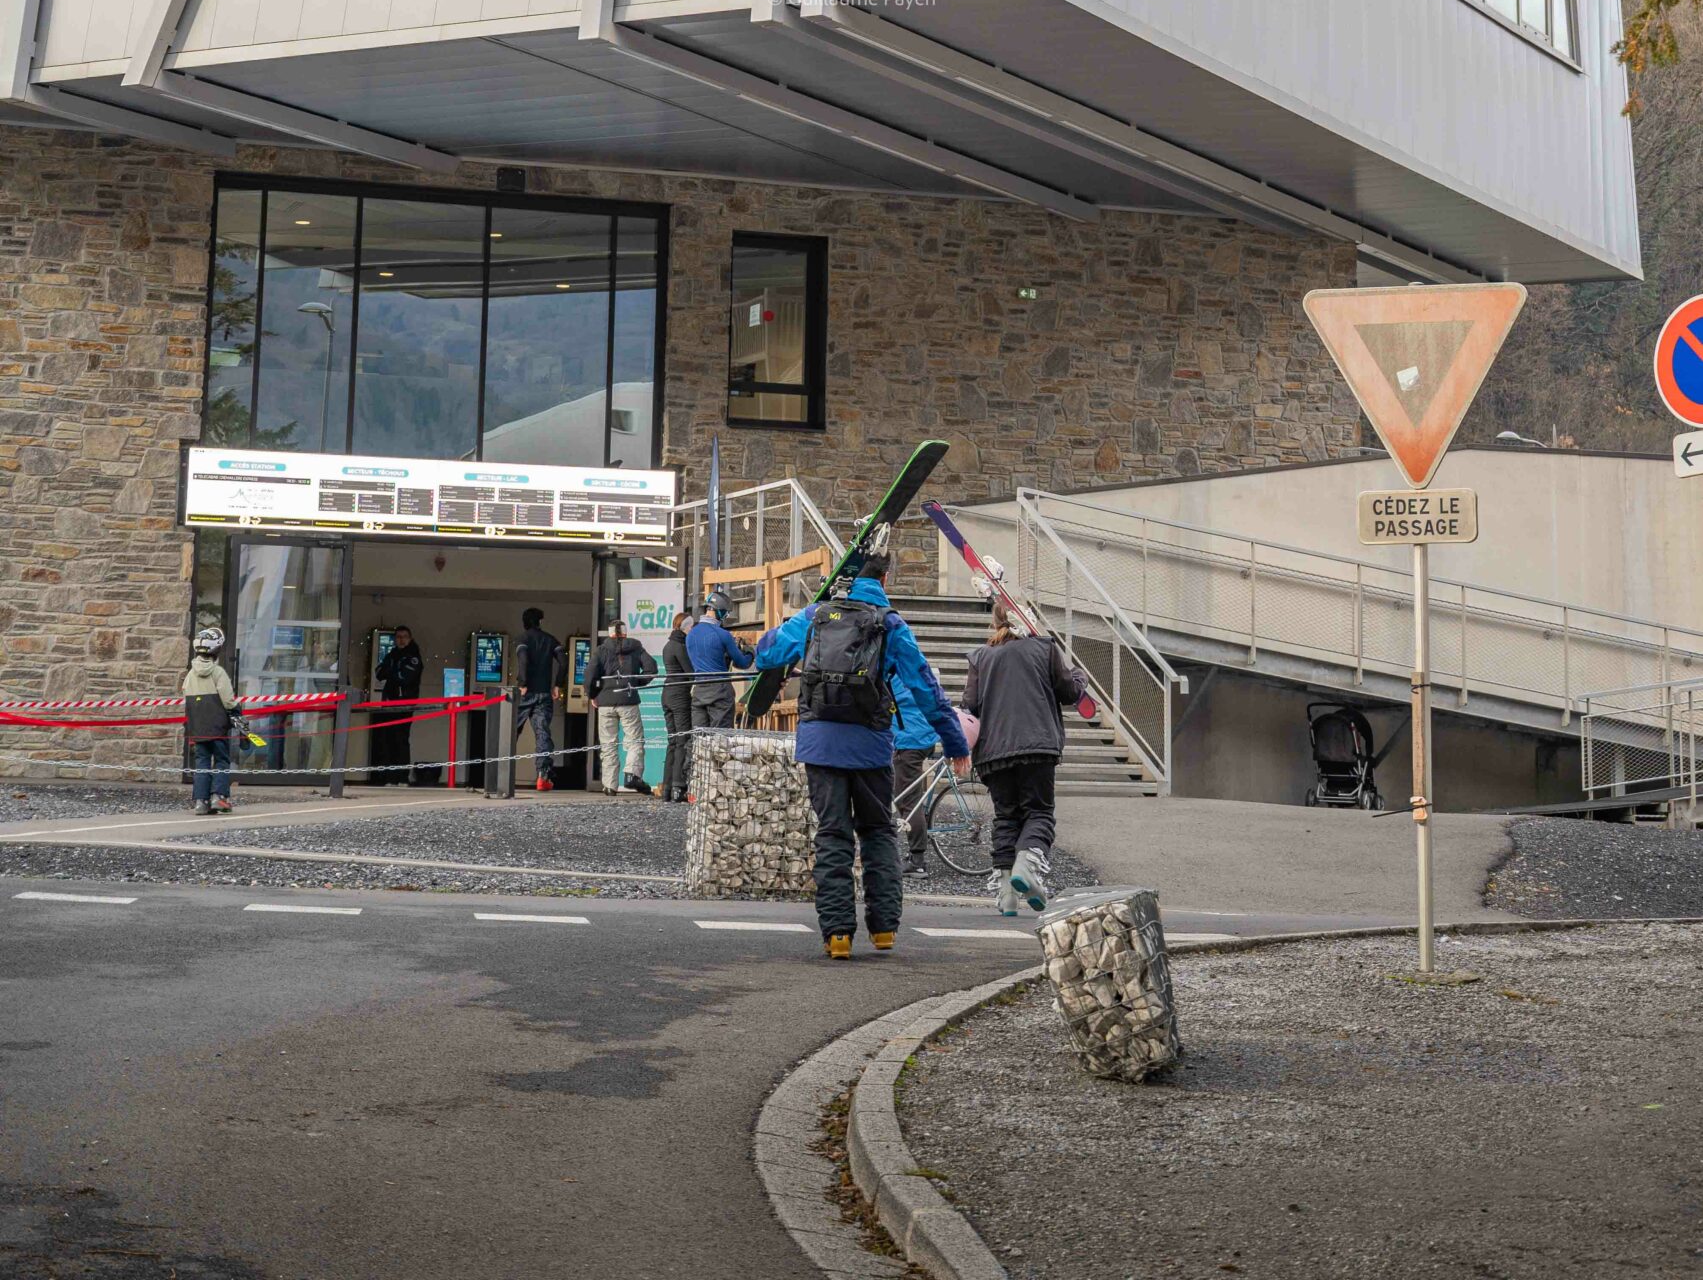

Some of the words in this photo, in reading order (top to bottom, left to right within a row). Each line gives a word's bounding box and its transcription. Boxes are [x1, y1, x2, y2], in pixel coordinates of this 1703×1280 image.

[1372, 496, 1430, 515] CÉDEZ
[1440, 497, 1460, 514] LE
[1375, 519, 1459, 536] PASSAGE
[627, 604, 674, 630] vali
